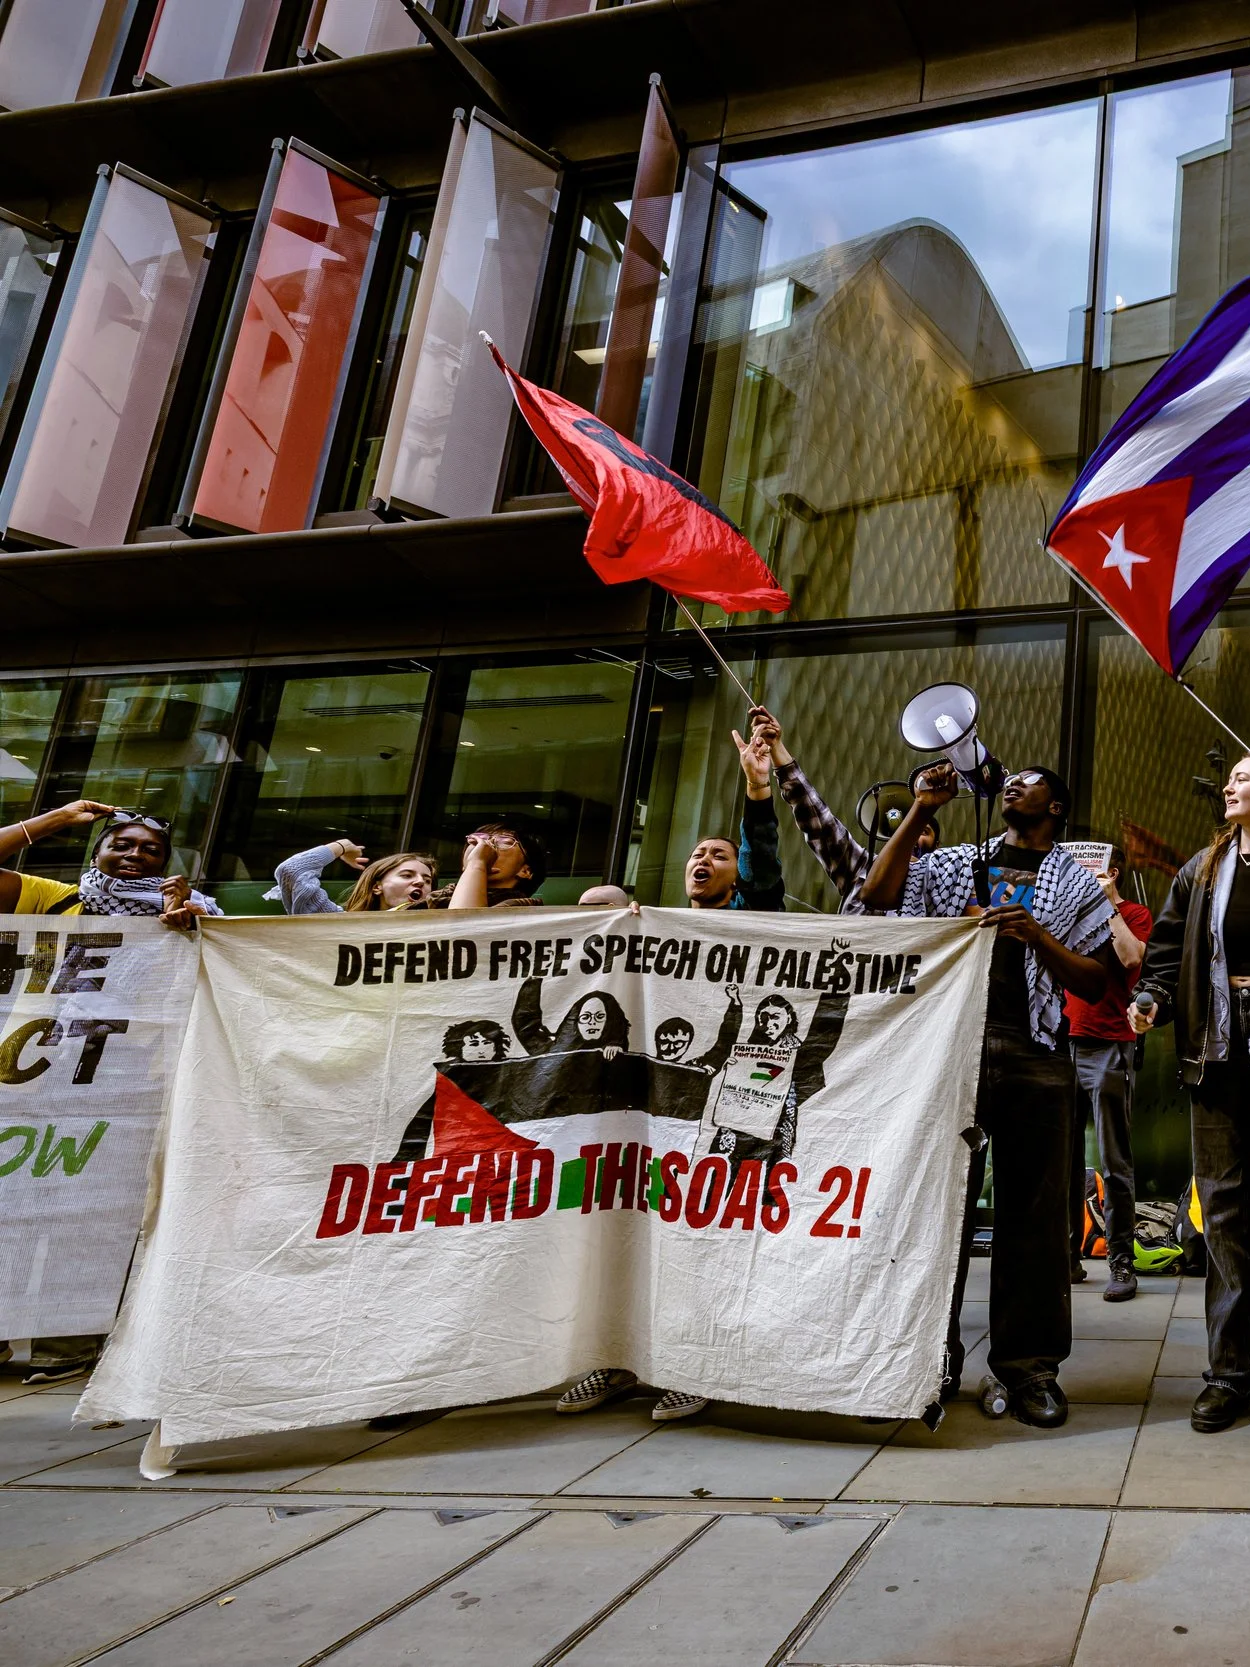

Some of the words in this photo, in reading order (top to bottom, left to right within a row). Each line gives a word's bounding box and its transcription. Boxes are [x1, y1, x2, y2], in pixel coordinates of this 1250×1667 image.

[334, 940, 477, 986] DEFEND
[489, 938, 573, 981] FREE
[580, 934, 701, 980] SPEECH
[705, 944, 751, 983] ON
[755, 948, 921, 995] PALESTINE
[757, 1046, 792, 1056] RACISM!
[316, 1148, 555, 1240] DEFEND
[579, 1142, 652, 1215] THE
[658, 1150, 798, 1235] SOAS
[810, 1165, 871, 1239] 2!
